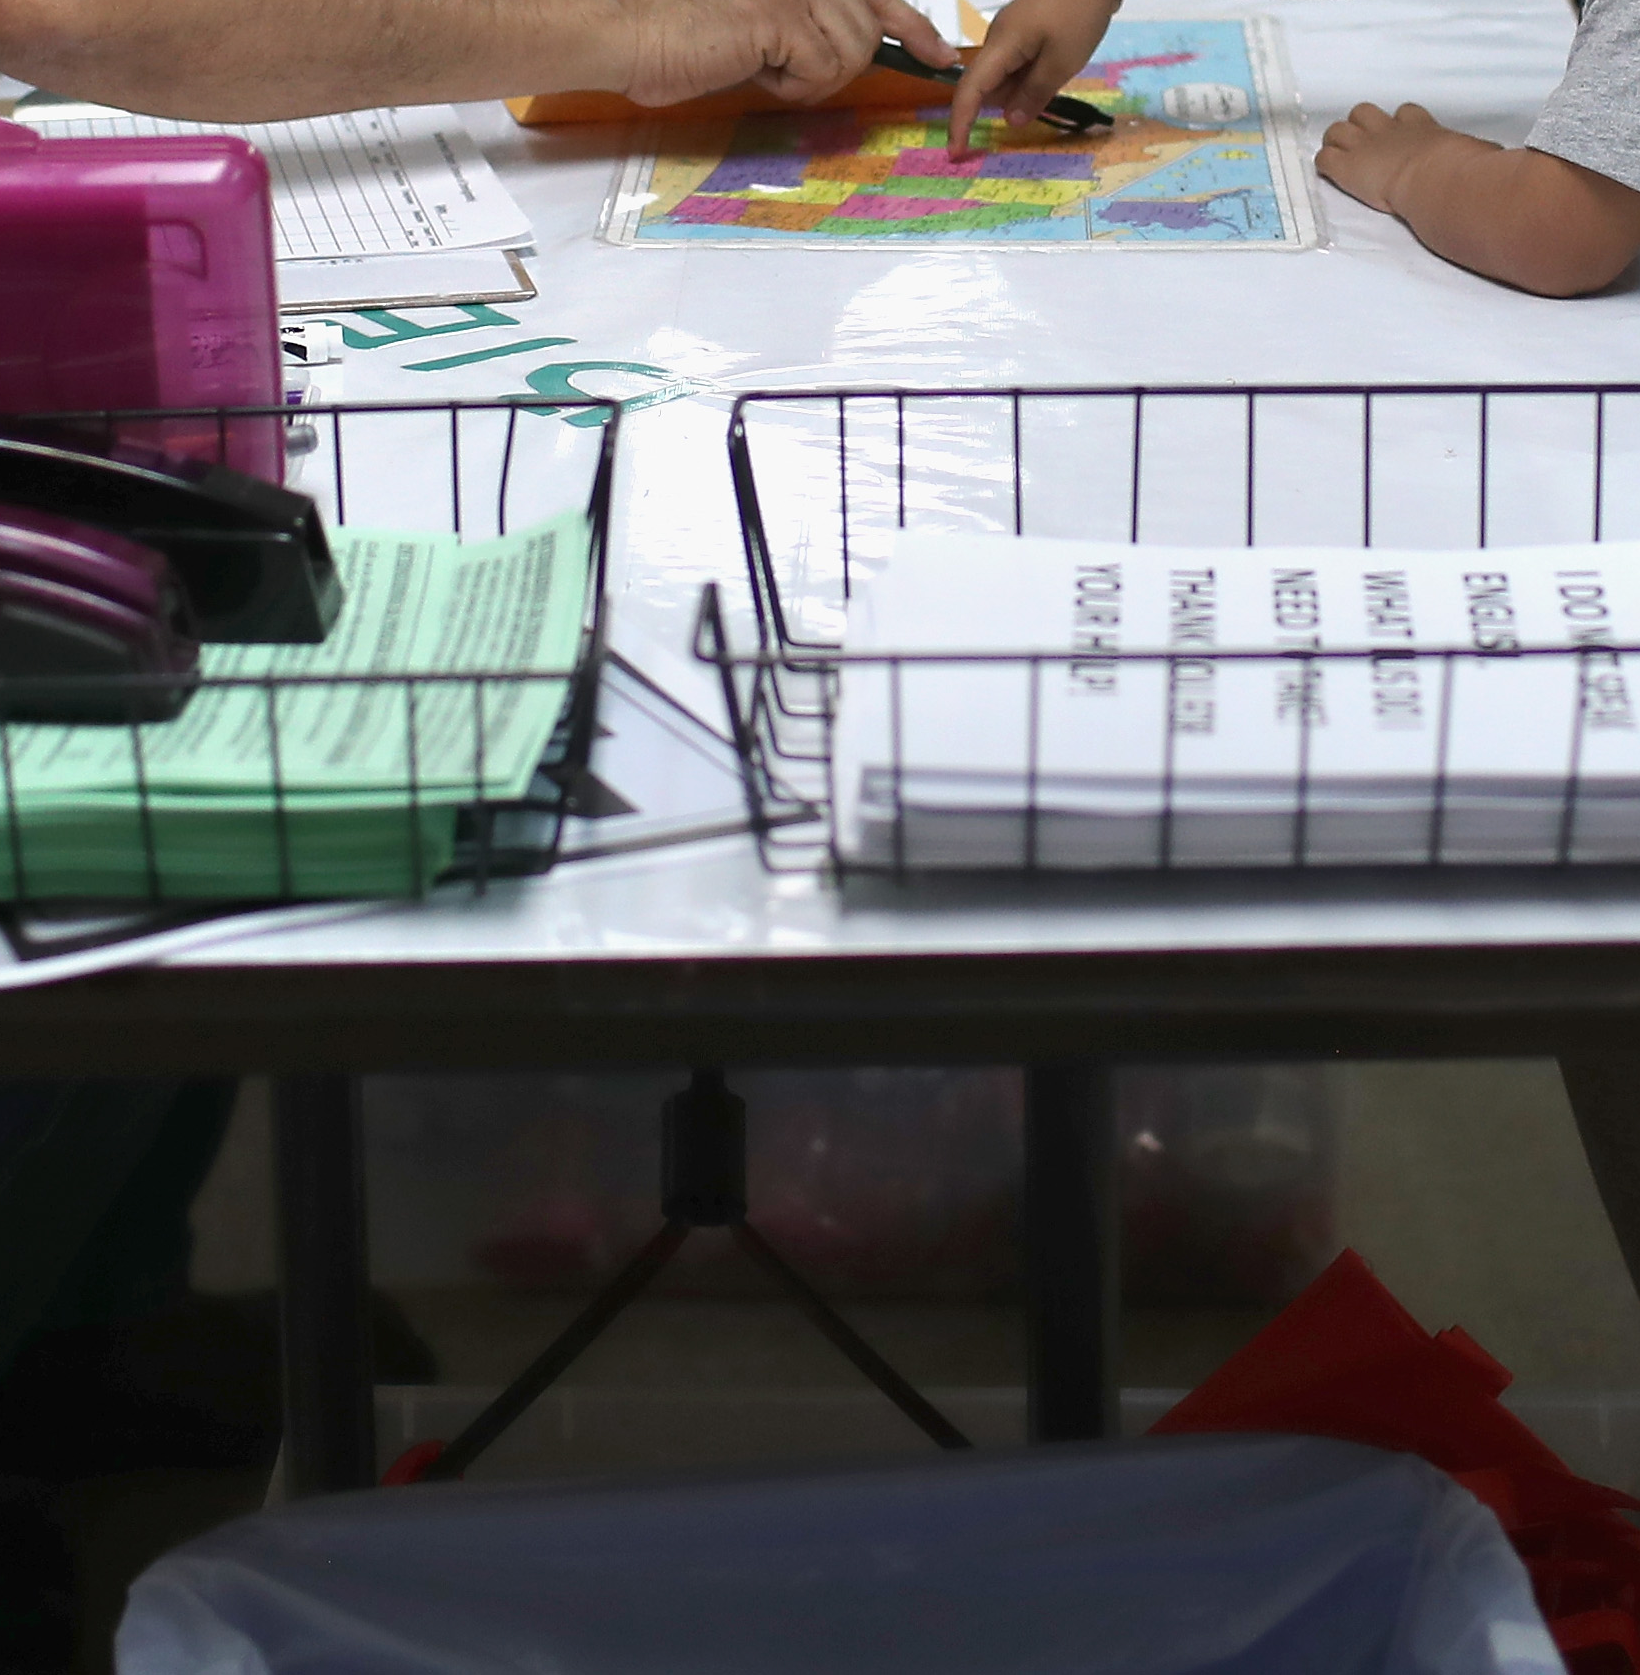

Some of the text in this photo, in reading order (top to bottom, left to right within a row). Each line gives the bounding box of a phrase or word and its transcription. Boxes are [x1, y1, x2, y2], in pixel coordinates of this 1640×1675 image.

[1074, 562, 1121, 627] YOUR
[1169, 567, 1216, 648] THANK
[1270, 567, 1321, 630] NEED
[1363, 570, 1415, 638] WHAT
[1559, 584, 1609, 619] DO
